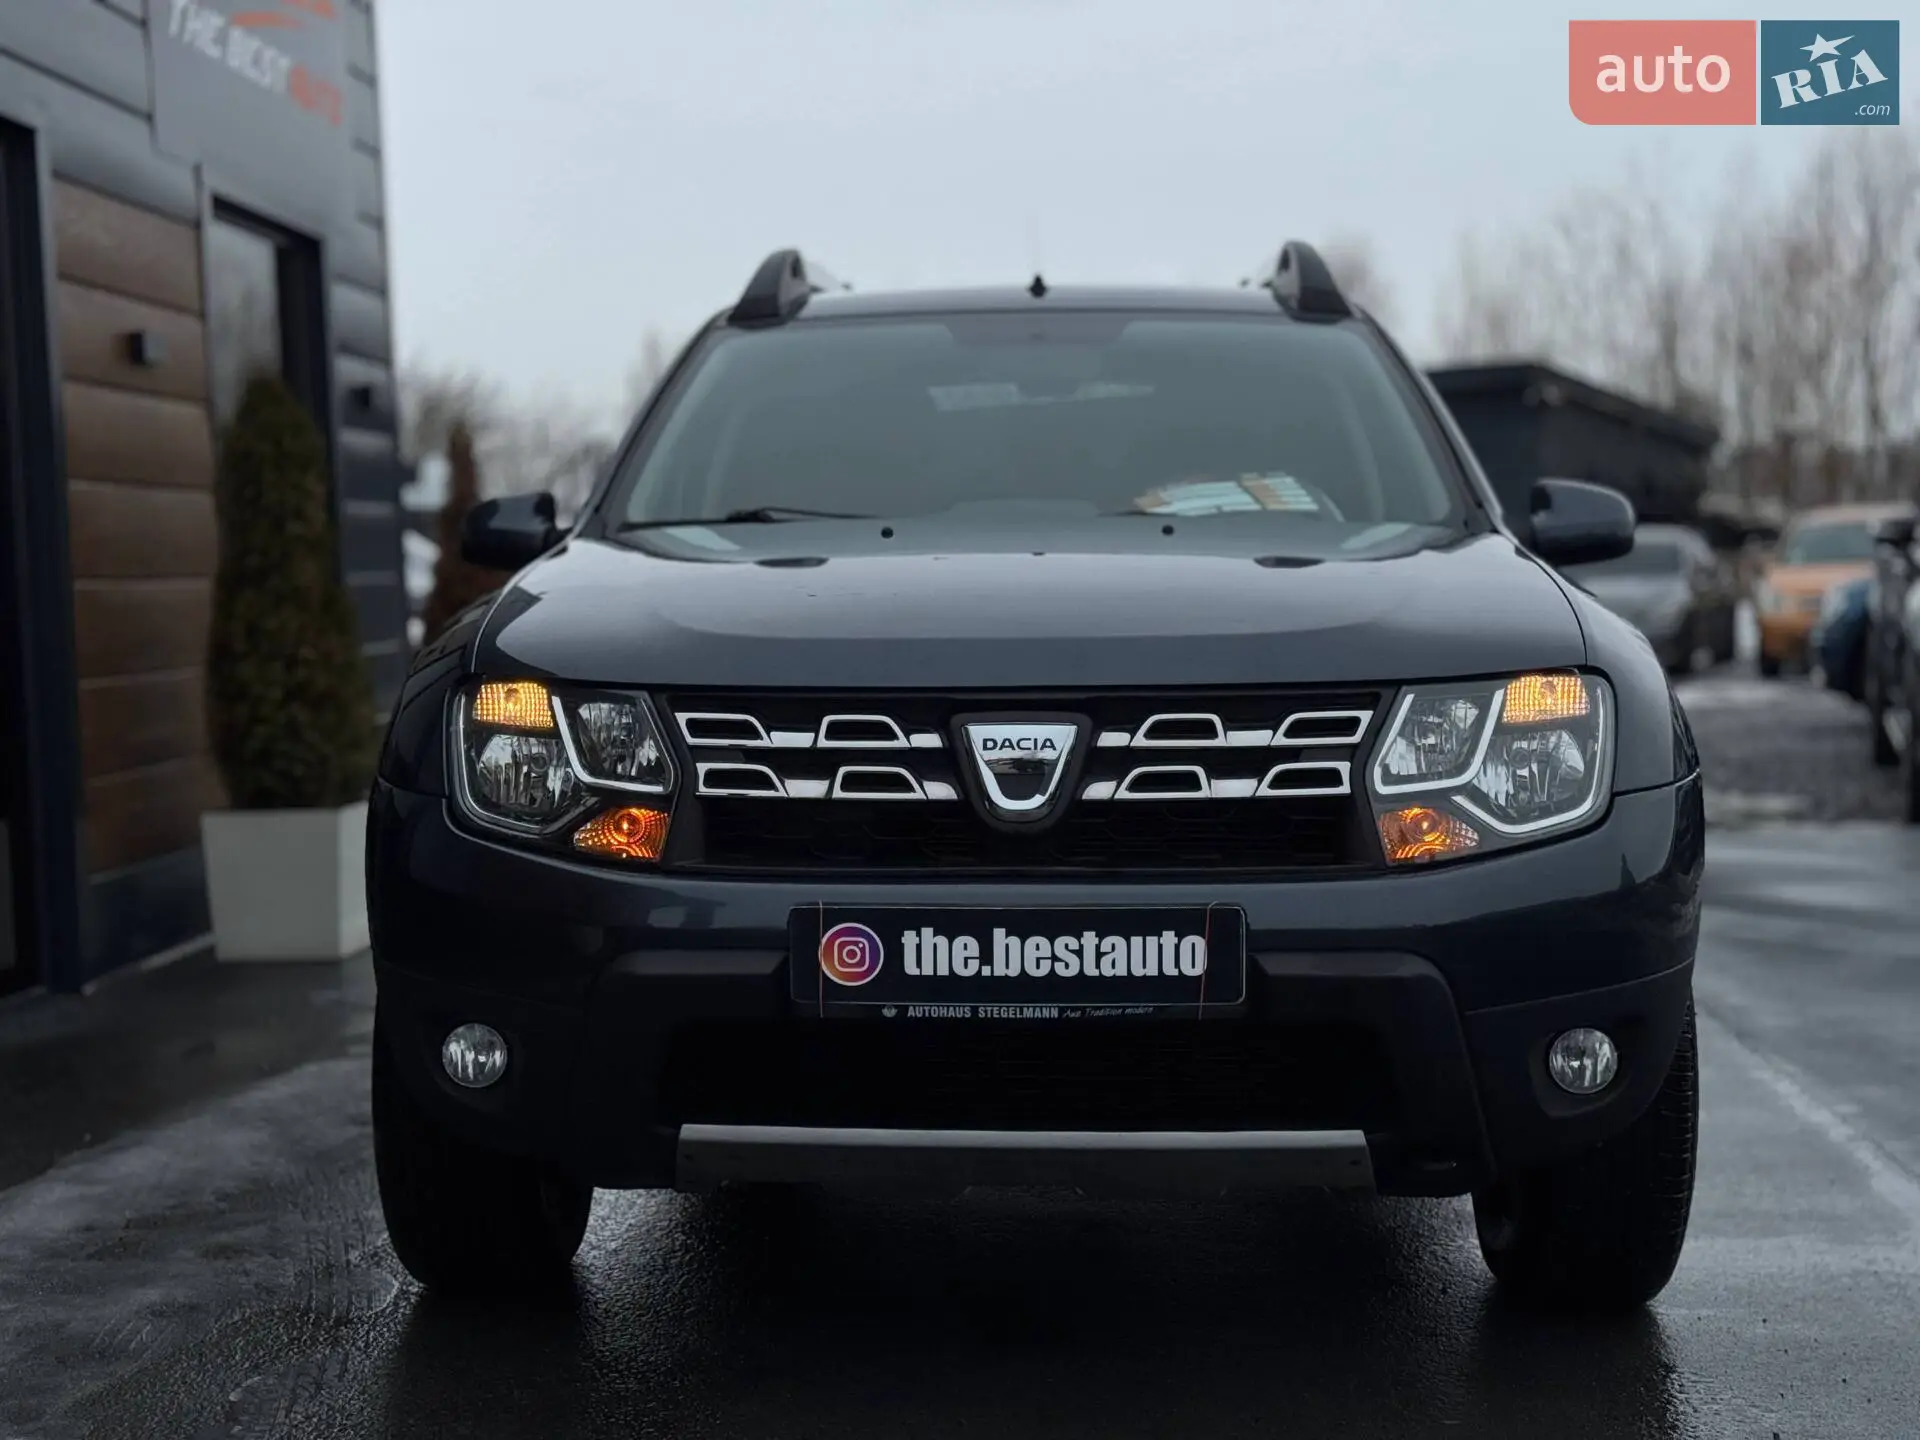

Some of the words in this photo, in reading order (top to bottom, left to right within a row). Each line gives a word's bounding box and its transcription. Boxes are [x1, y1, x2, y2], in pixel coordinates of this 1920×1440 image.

[167, 0, 223, 59] THE
[226, 26, 291, 95] BEST
[982, 737, 1056, 751] DACIA
[901, 927, 1207, 977] the.bestauto
[907, 1006, 972, 1018] AUTOHAUS
[978, 1006, 1059, 1018] STEGELMANN
